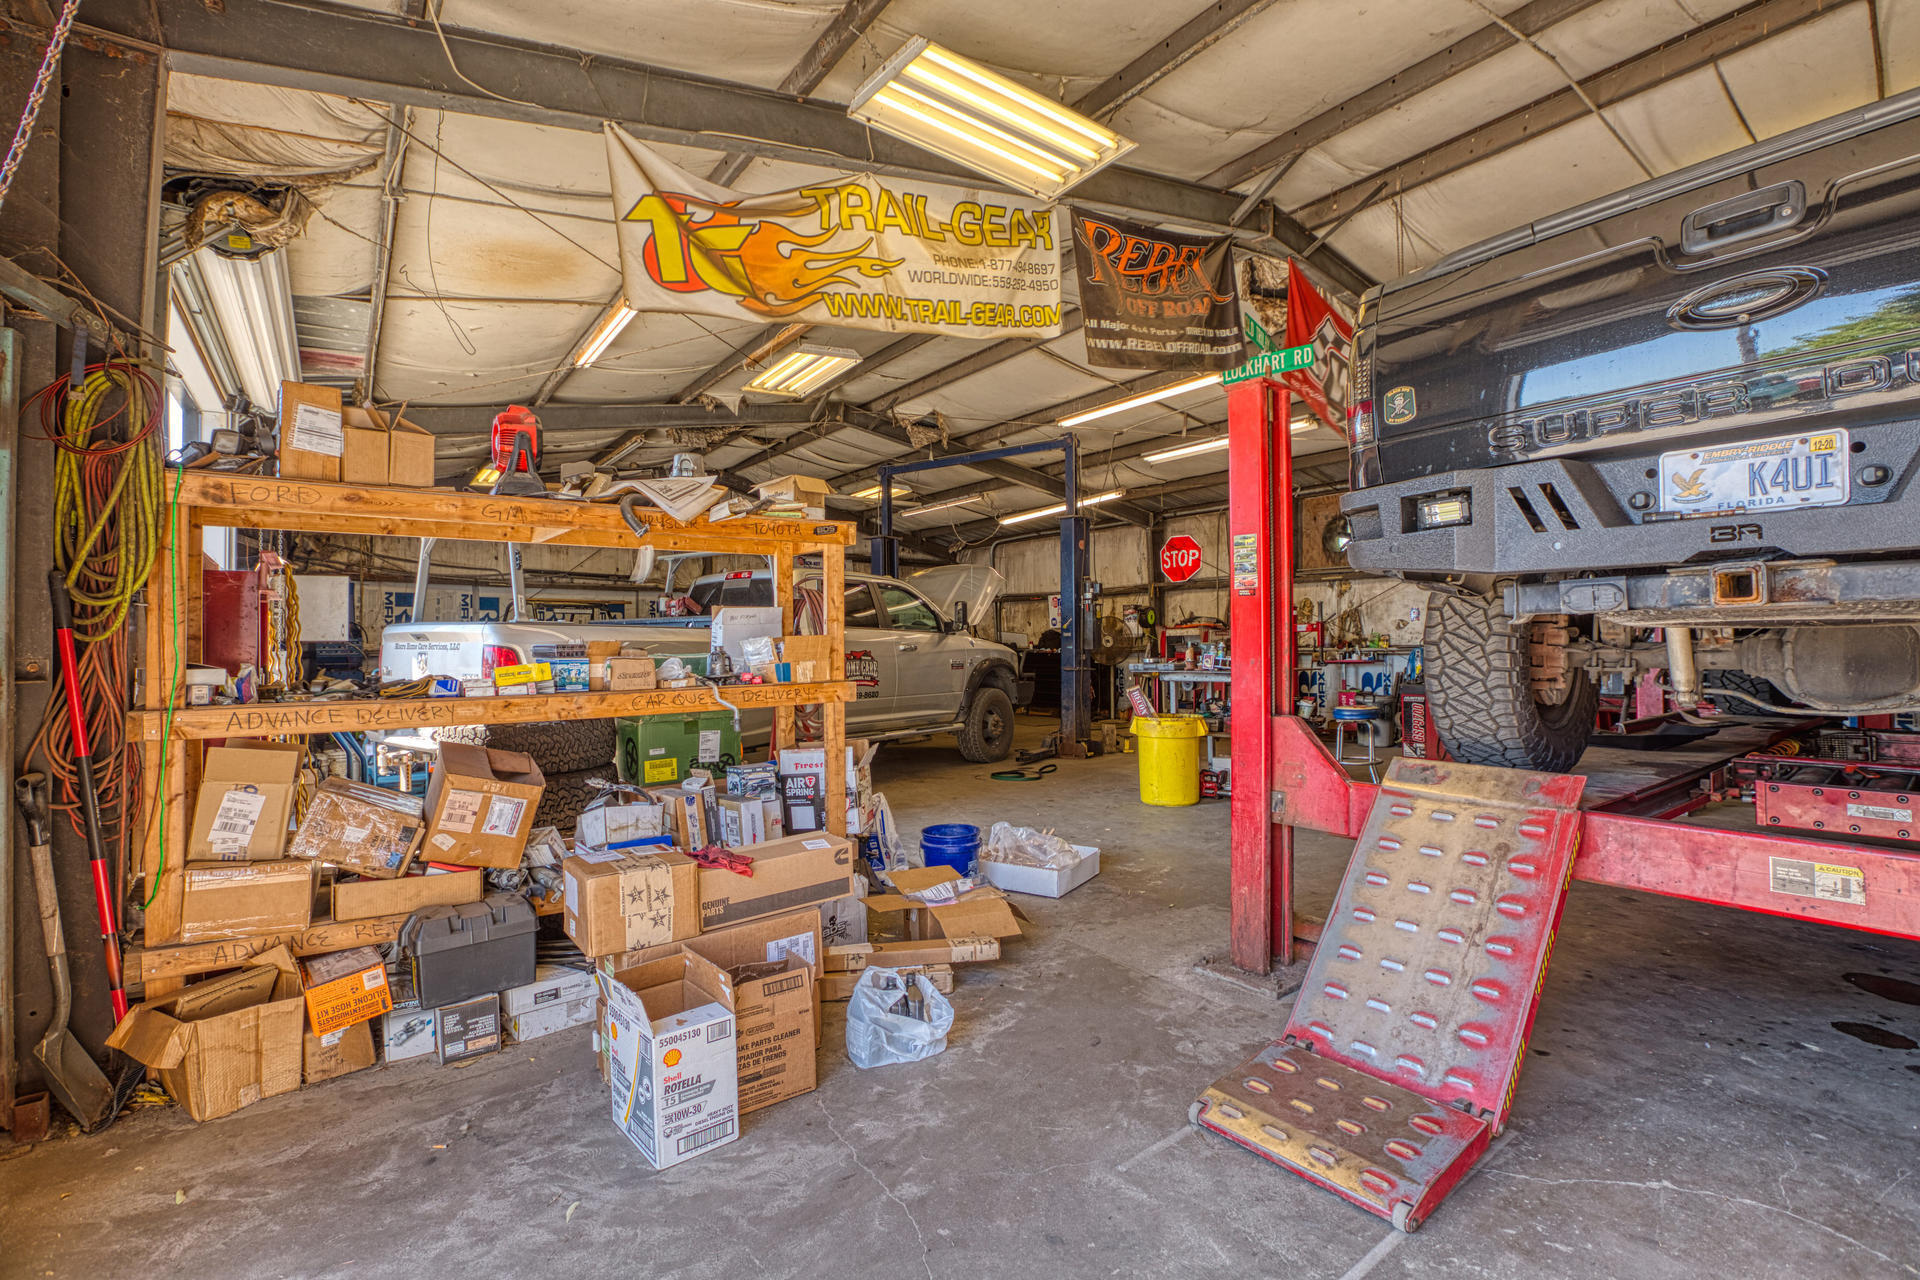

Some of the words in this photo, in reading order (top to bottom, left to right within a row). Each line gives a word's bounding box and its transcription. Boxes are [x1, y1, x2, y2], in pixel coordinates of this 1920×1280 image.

[800, 184, 1054, 251] TRAIL-GEAR
[1100, 319, 1130, 331] Major
[1294, 347, 1313, 367] RD
[1488, 380, 1752, 456] SUPER
[1703, 441, 1795, 460] EMBRY-RIDDLE
[1813, 441, 1834, 452] 12-20
[1748, 452, 1834, 498] K4UI
[229, 483, 322, 505] FORD
[1717, 495, 1785, 510] FLORIDA
[481, 503, 528, 521] GM
[753, 523, 803, 536] TOYOTA
[1163, 550, 1199, 569] STOP
[631, 695, 668, 711] CAR
[741, 688, 811, 703] DELIVERY
[226, 708, 345, 732] ADVANCE
[357, 704, 456, 725] DELIVERY
[793, 762, 824, 771] Firest
[786, 777, 805, 789] AIR
[785, 787, 815, 797] SPRING
[1826, 868, 1860, 877] CAUTION
[702, 897, 730, 910] GENUINE
[703, 906, 725, 918] PARTS
[213, 931, 335, 965] ADVANCE
[355, 988, 388, 1005] SILICONE
[316, 1006, 328, 1019] KIT
[330, 1000, 352, 1014] HOSE
[659, 1028, 701, 1048] 550045130
[751, 1036, 772, 1048] PARTS
[773, 1028, 801, 1041] CLEANER
[752, 1058, 761, 1066] DE
[762, 1050, 787, 1063] FRENOS
[765, 1044, 782, 1055] PARA
[663, 1072, 682, 1085] Shell
[664, 1073, 703, 1096] ROTELLA
[673, 1103, 702, 1121] 10W-30
